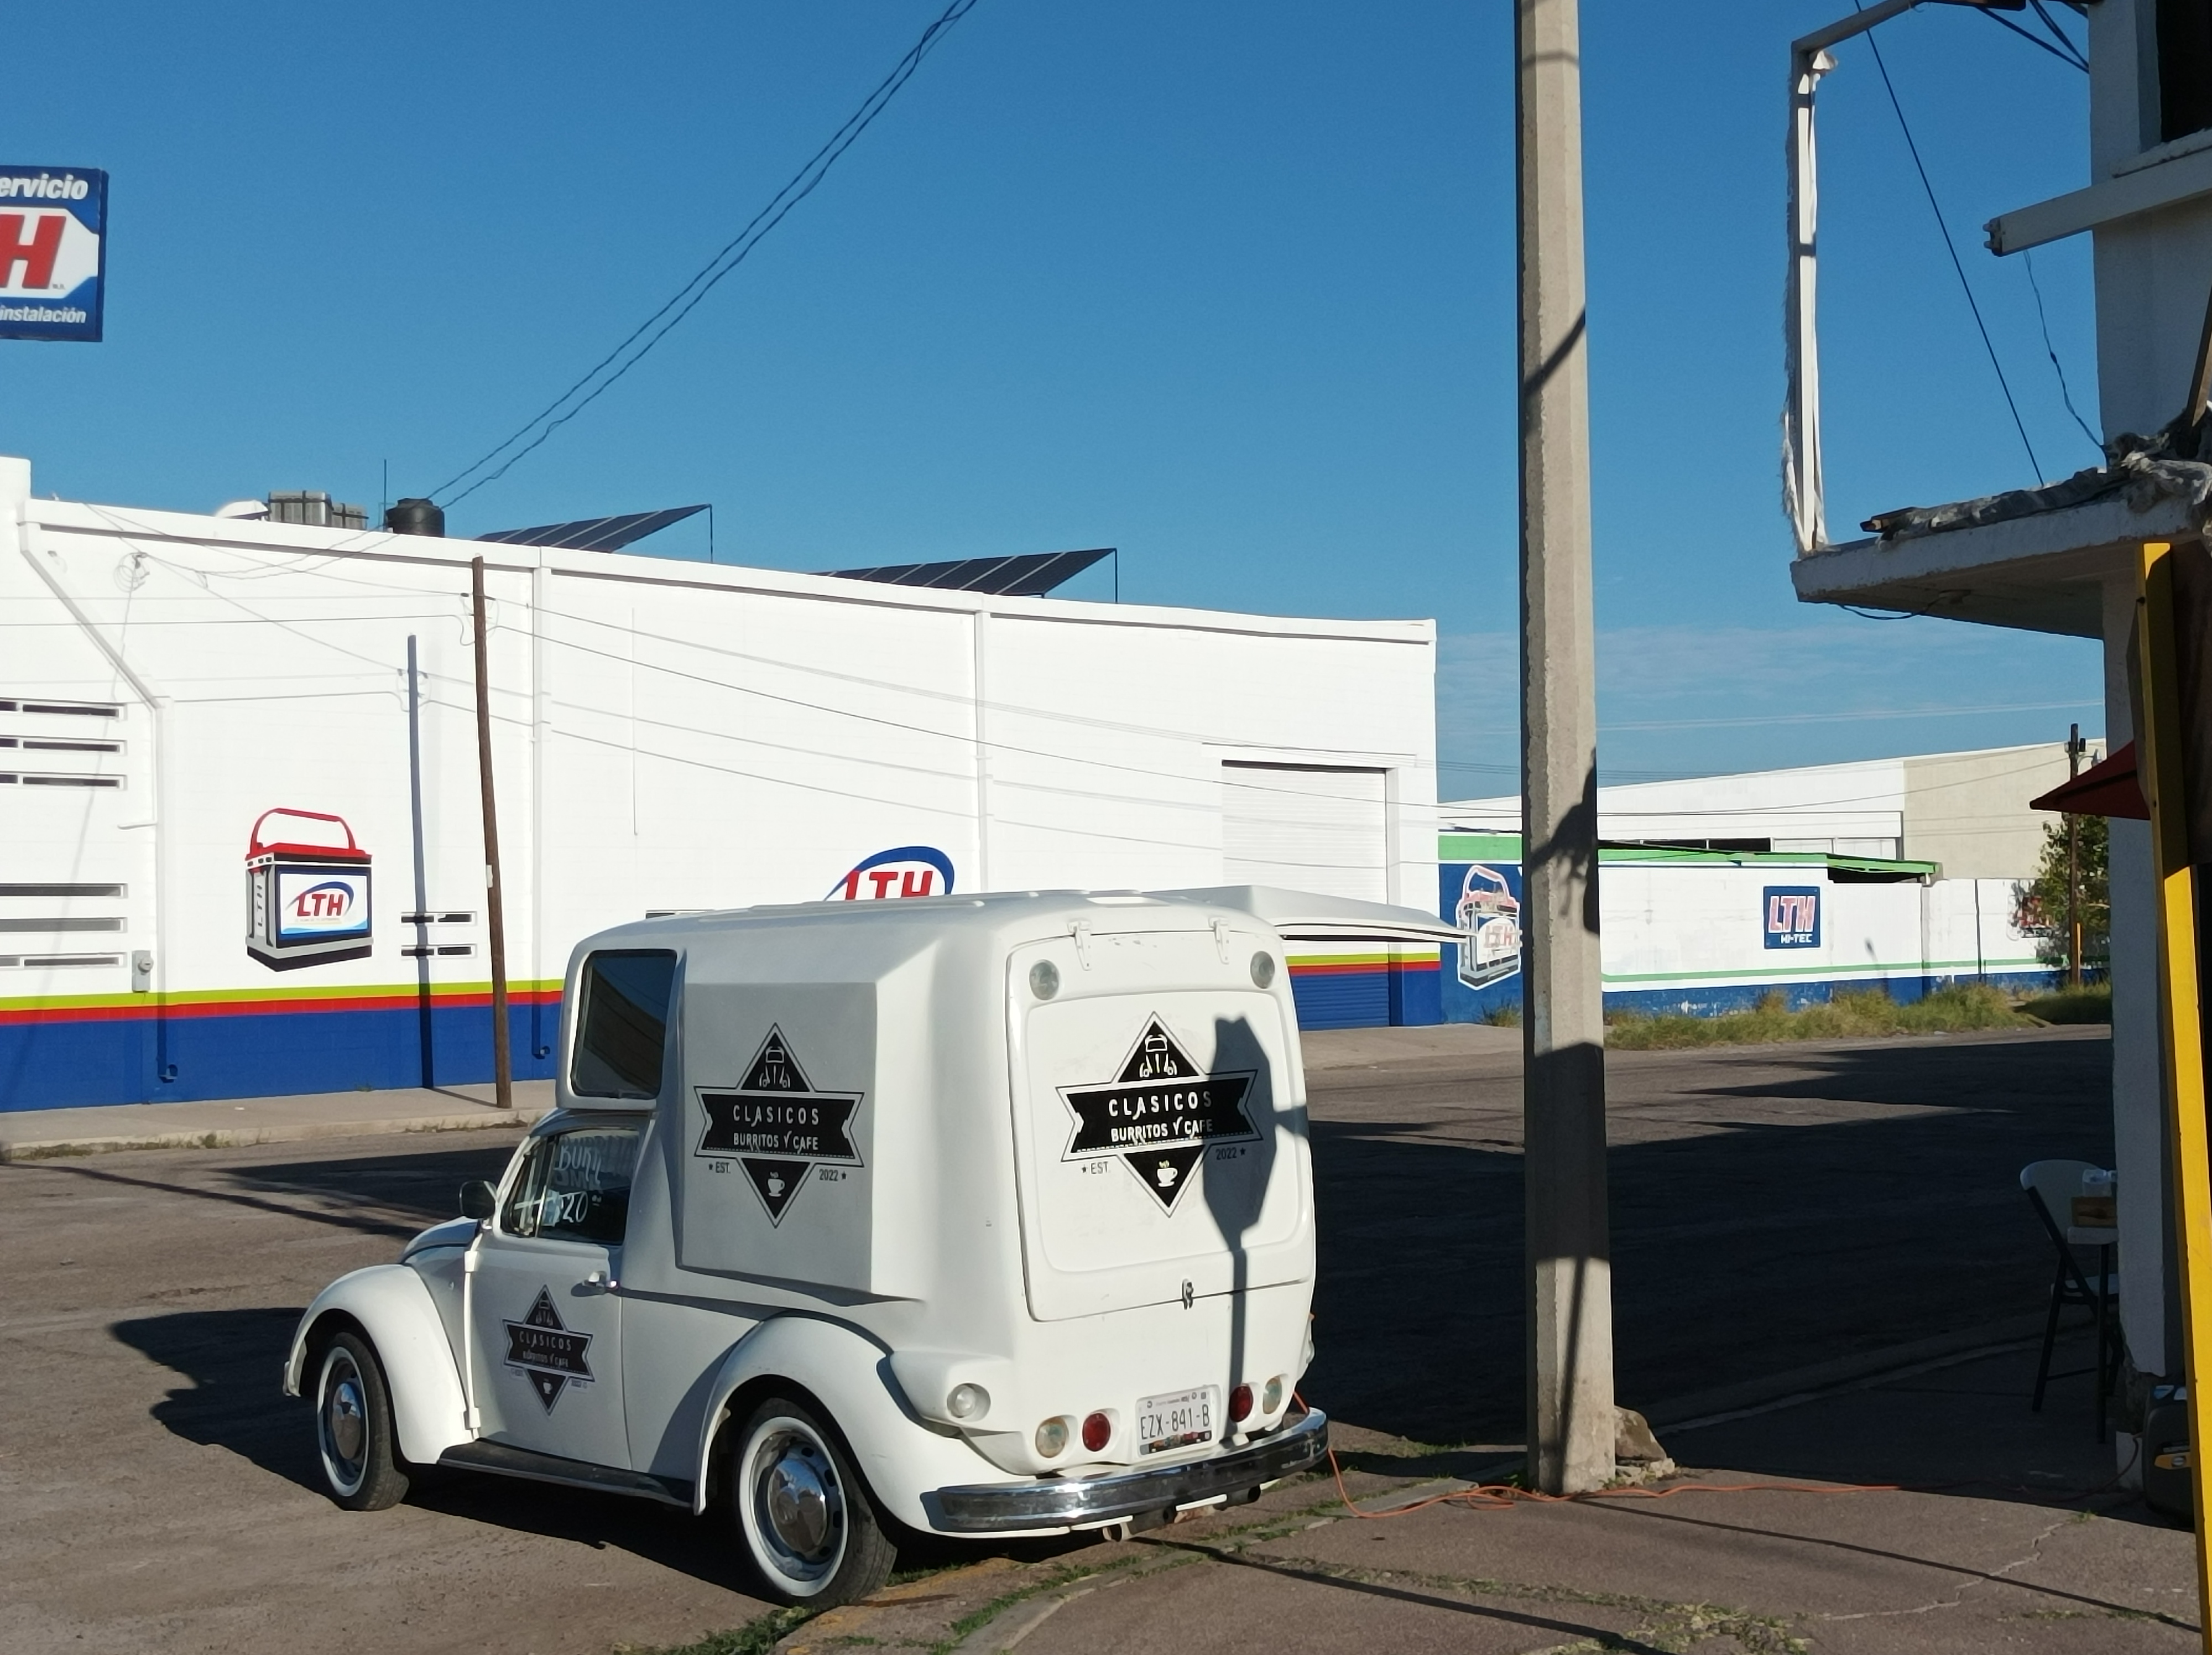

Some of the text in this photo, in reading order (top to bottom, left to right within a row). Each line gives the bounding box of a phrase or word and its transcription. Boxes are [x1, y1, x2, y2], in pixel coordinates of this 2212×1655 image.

[297, 894, 343, 917] LTH
[1768, 896, 1815, 933] LTH
[1781, 934, 1813, 944] HI-TEC
[733, 1105, 819, 1127] CLASICOS
[1109, 1091, 1212, 1120] CLASICOS
[1111, 1116, 1213, 1146] BURRITOS Y CAFE
[734, 1131, 818, 1155] BURRITOS Y CAFE
[1216, 1147, 1238, 1160] 2022
[819, 1169, 838, 1182] 2022
[519, 1331, 571, 1351] CLASICOS
[1140, 1404, 1210, 1440] EZX-841-B
